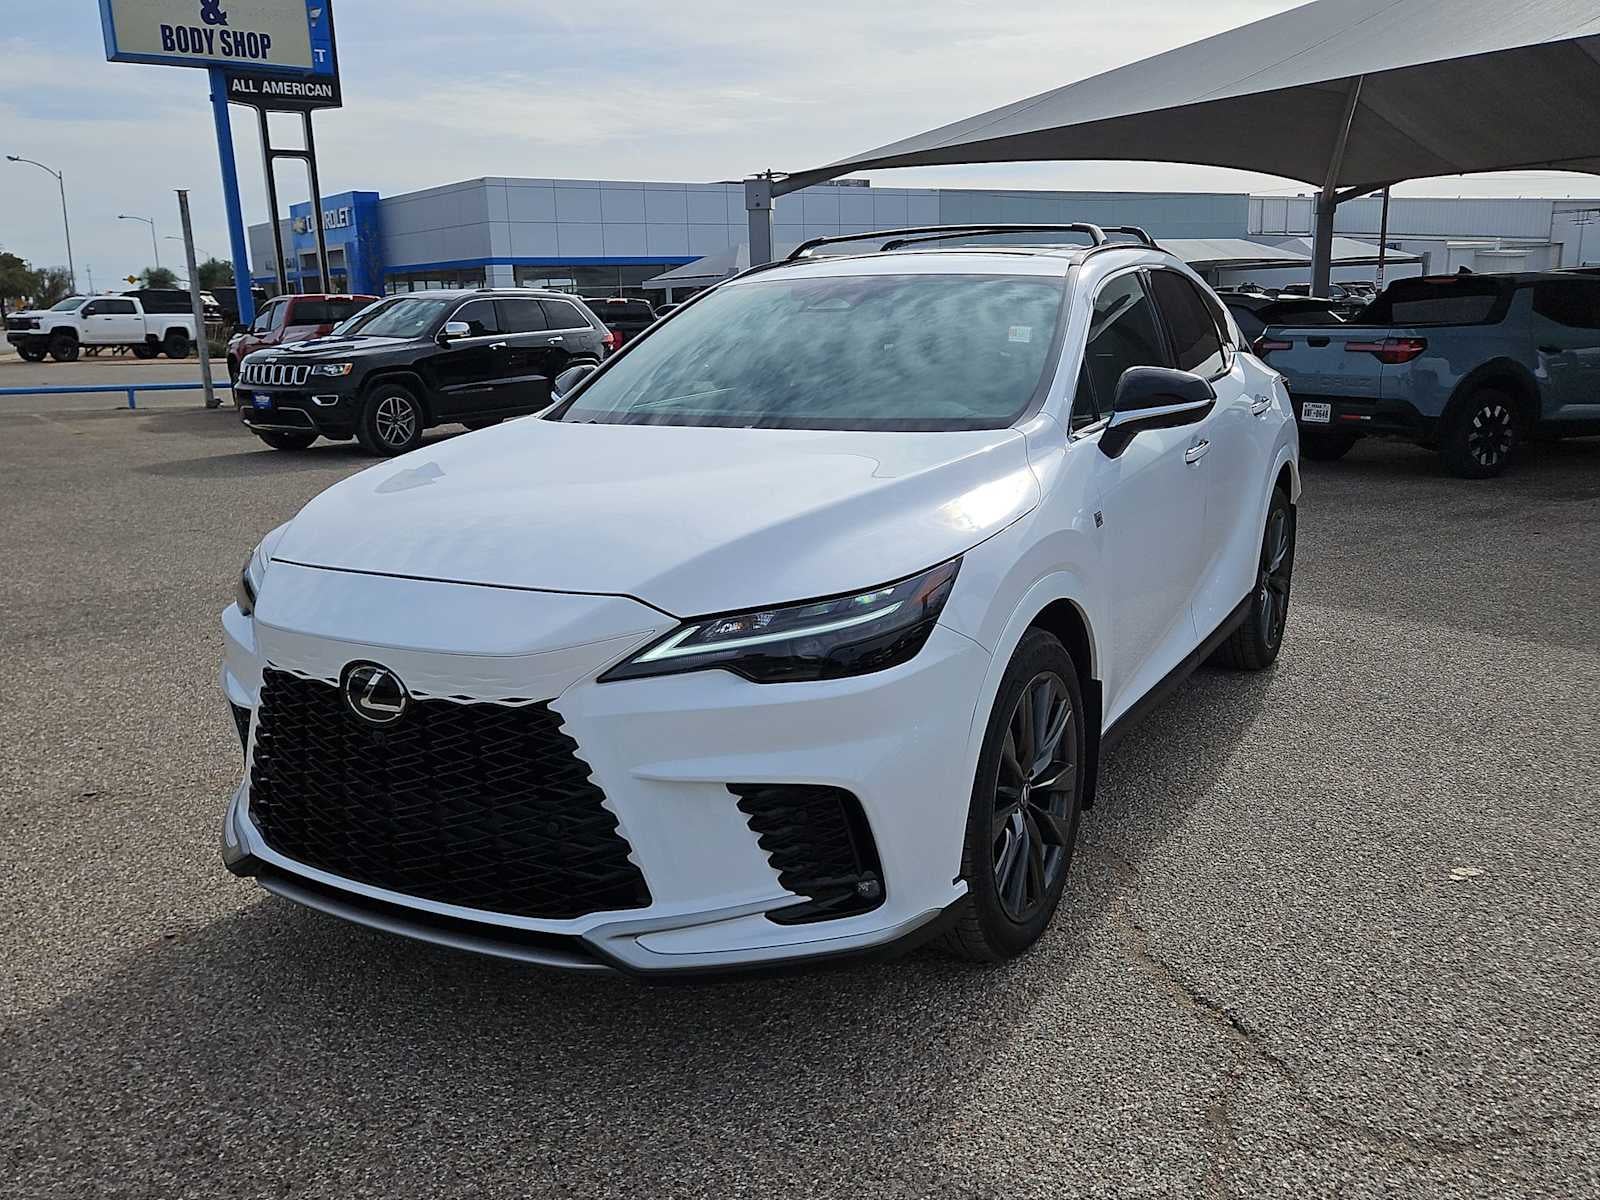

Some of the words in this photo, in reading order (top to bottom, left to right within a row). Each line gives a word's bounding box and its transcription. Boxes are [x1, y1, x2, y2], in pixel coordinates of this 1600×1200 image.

[160, 24, 215, 55] BODY
[219, 30, 272, 59] SHOP
[231, 78, 259, 94] ALL
[262, 81, 332, 97] AMERICAN
